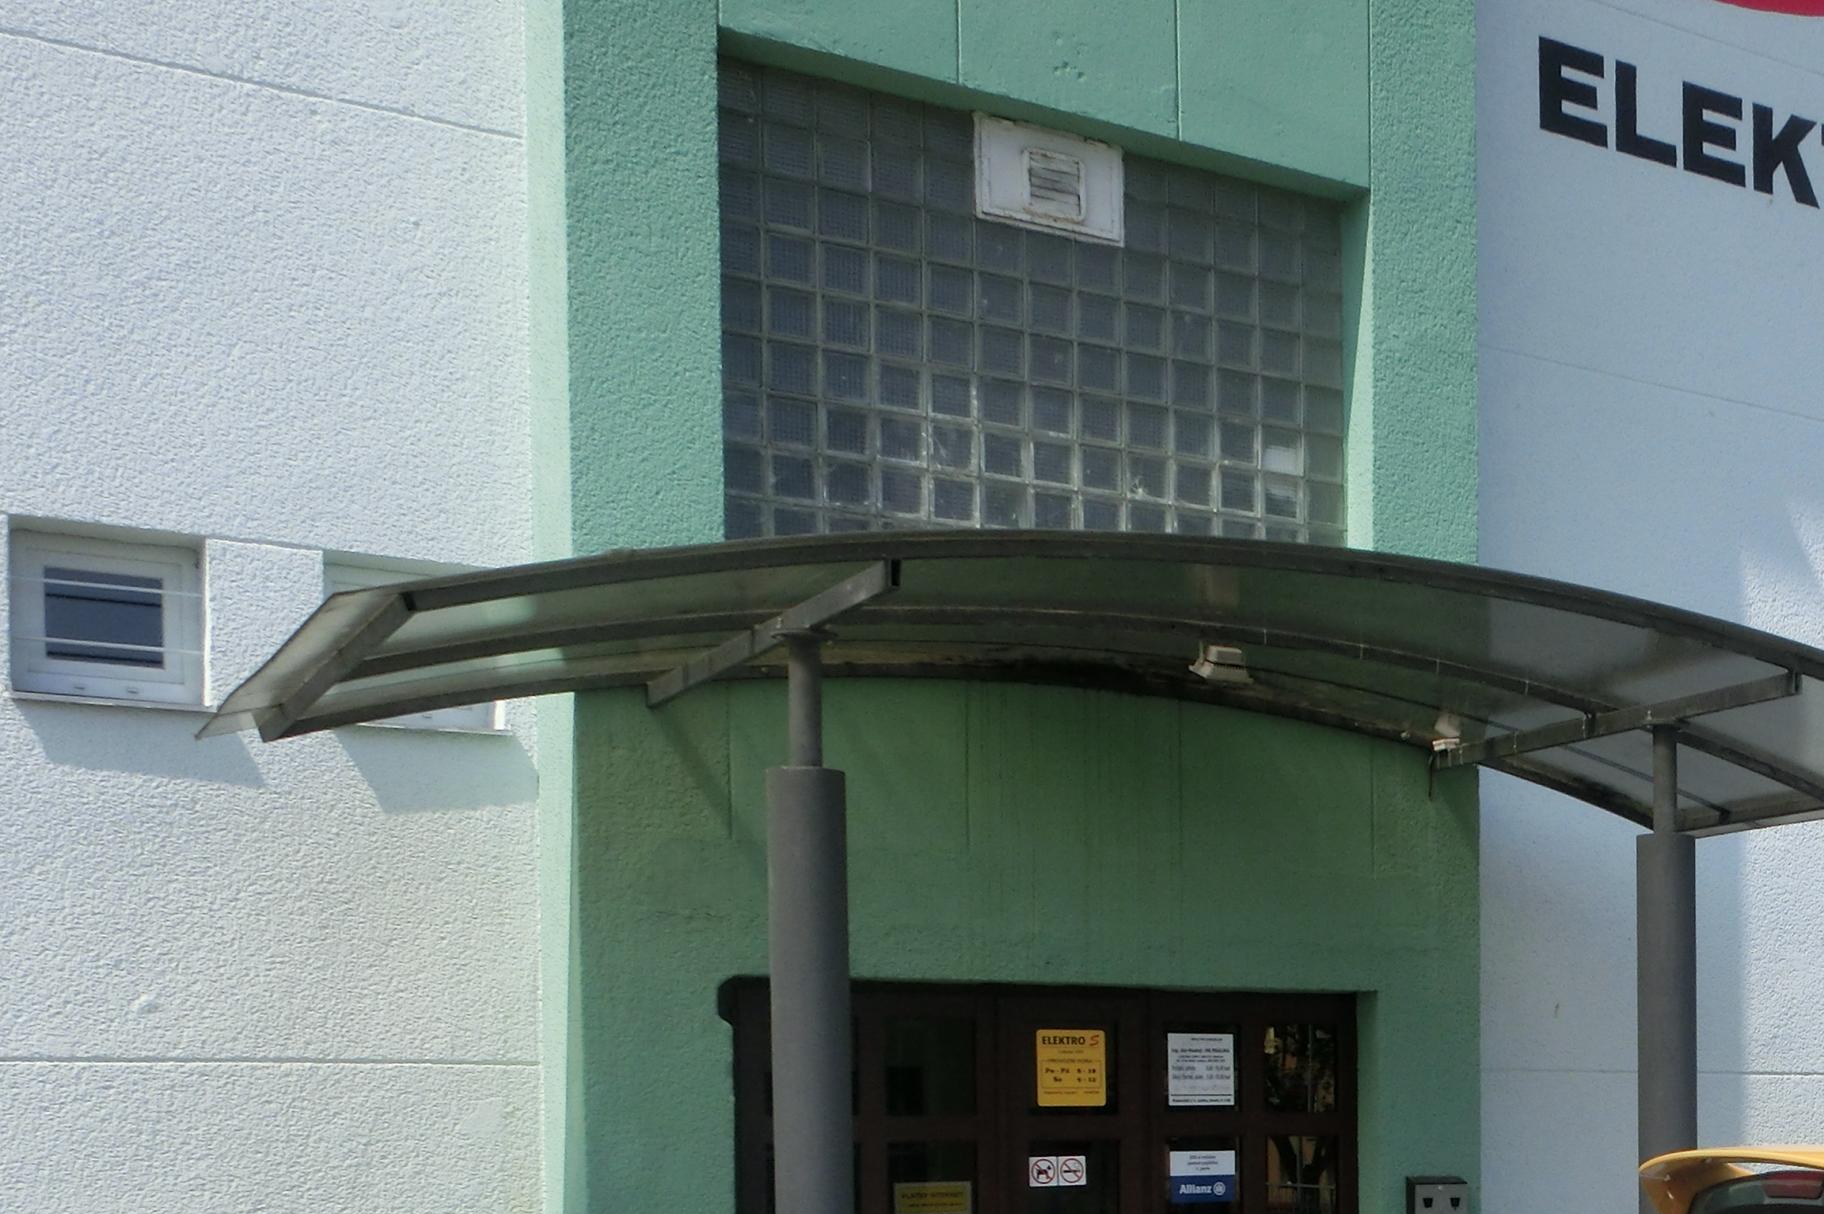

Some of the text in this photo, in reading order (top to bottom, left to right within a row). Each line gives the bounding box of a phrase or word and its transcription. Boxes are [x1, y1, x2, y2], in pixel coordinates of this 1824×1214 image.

[1041, 1034, 1100, 1047] ELEKTRO S
[1179, 1184, 1212, 1194] Allianz
